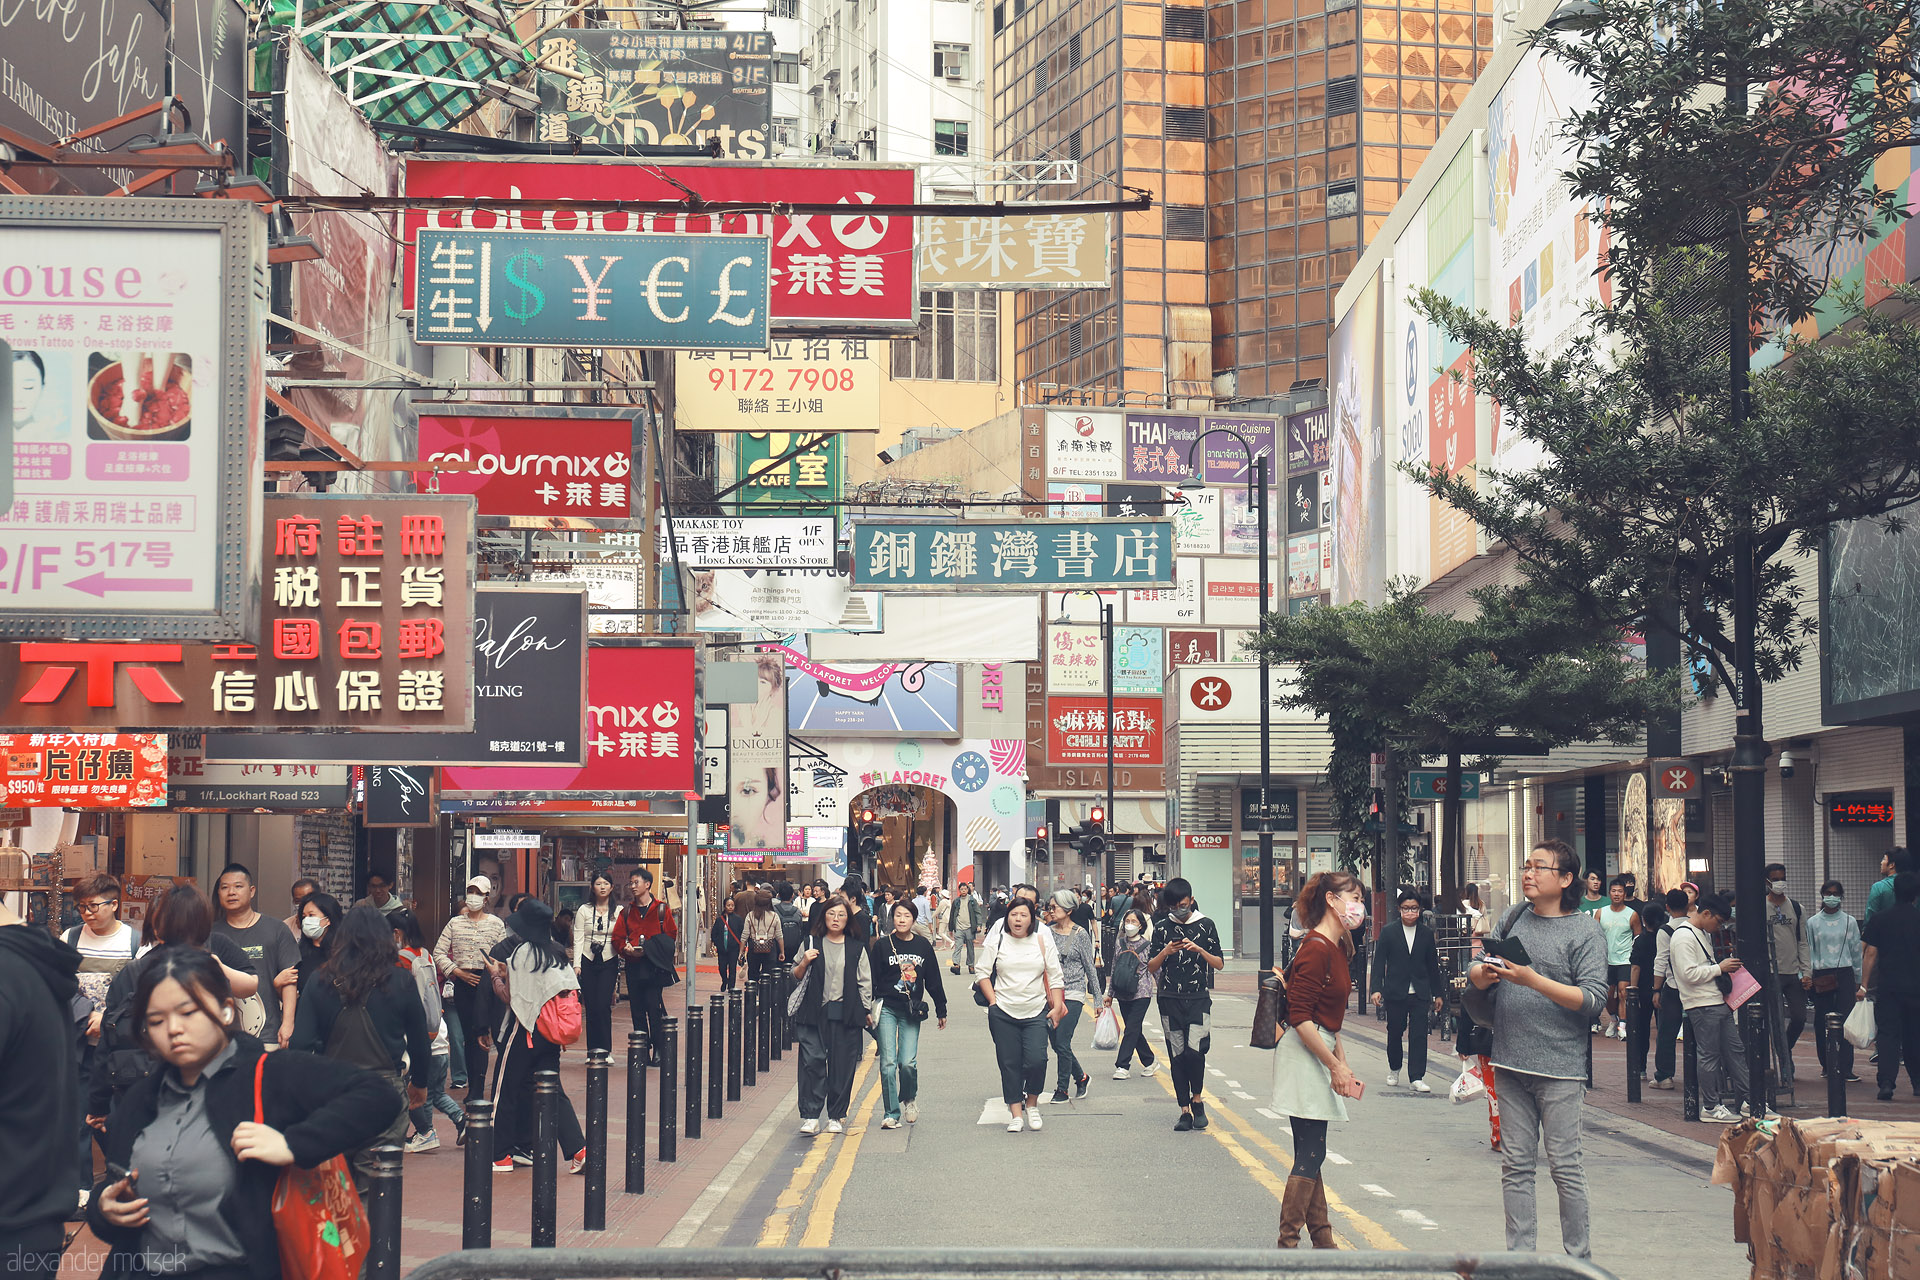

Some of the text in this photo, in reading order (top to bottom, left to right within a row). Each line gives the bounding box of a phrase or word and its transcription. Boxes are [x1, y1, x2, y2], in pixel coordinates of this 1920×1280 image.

[733, 34, 766, 51] 4/F
[732, 67, 767, 84] 3/F
[1534, 122, 1554, 168] SOGO
[772, 254, 885, 297] 萊美
[427, 240, 475, 334] 生生
[41, 336, 74, 348] Tattoo
[84, 336, 133, 350] One-stop
[135, 337, 173, 350] Service
[708, 368, 855, 392] 9172 7908
[738, 398, 823, 413] 聯絡 王小姐
[1129, 421, 1198, 445] THAI Perfect
[1240, 423, 1271, 434] Cuisine
[1401, 408, 1424, 462] SOGO
[1028, 423, 1040, 480] 金百利
[1052, 466, 1067, 475] 8/F
[759, 475, 791, 486] CAFE
[535, 481, 626, 507] 卡萊美
[1198, 495, 1214, 504] 7/F
[722, 520, 745, 529] TOY
[802, 525, 822, 536] 1/F
[74, 541, 174, 568] 517号
[699, 555, 726, 564] HONG
[728, 555, 754, 564] KONG
[799, 555, 829, 564] STORE
[868, 528, 1160, 579] 銅鑼灣書店
[1177, 609, 1194, 617] 6/F
[800, 660, 813, 671] TO
[813, 666, 853, 686] LAFORET
[210, 670, 445, 712] 信心保證
[28, 733, 118, 747] 新年大特價
[489, 740, 566, 753] 駱克道521號一樓
[588, 732, 680, 758] 卡萊美
[731, 738, 783, 750] UNIQUE
[1066, 735, 1100, 748] CHILI
[955, 754, 986, 770] HAPPY
[884, 770, 947, 790] LAFORET
[959, 778, 984, 790] YARN
[51, 785, 127, 794] 限時優惠 勿失良機
[269, 791, 298, 801] Road
[301, 791, 320, 801] 523
[1249, 803, 1290, 813] 銅灣站
